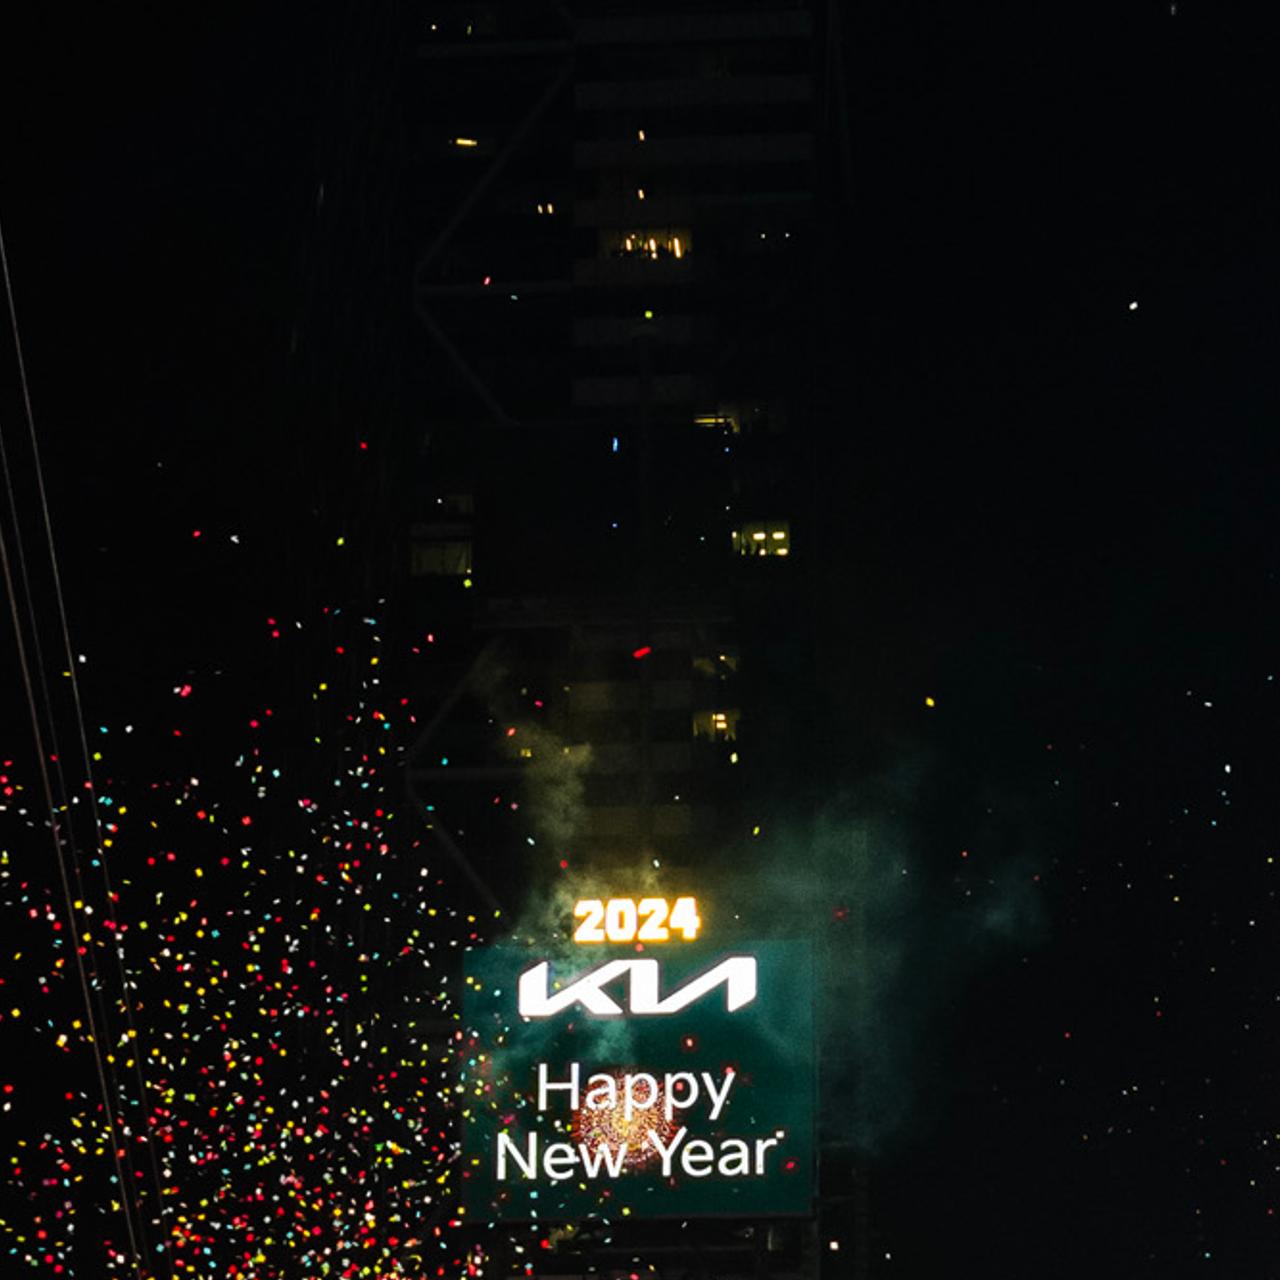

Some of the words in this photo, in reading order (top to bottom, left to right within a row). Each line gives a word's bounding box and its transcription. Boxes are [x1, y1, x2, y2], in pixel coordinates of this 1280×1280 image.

[574, 897, 701, 943] 2024
[519, 956, 757, 1016] KIA
[538, 1062, 735, 1120] Happy
[496, 1131, 628, 1180] New
[646, 1126, 778, 1177] Year
